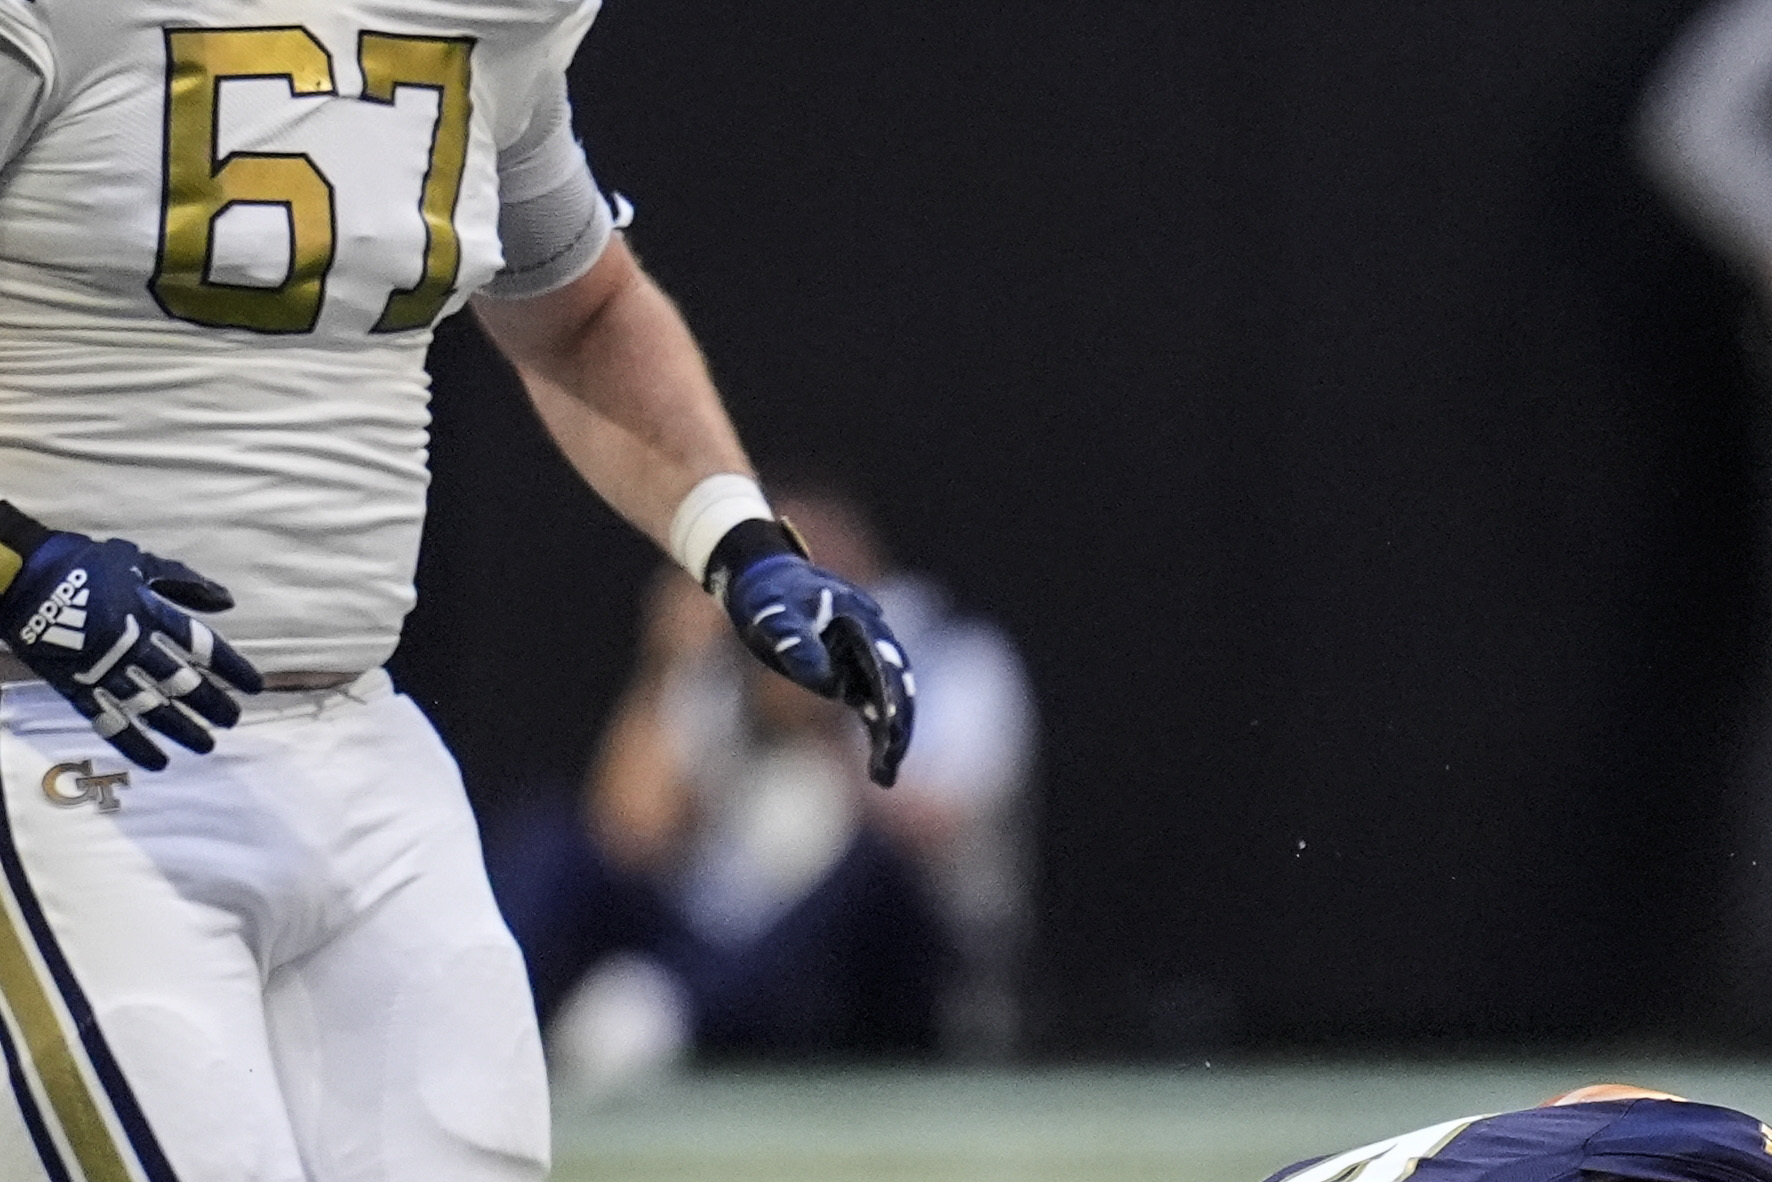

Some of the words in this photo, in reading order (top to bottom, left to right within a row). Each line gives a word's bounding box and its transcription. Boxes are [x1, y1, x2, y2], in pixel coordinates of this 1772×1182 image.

[148, 25, 478, 335] 67
[20, 568, 88, 645] adidas
[42, 760, 130, 813] GT
